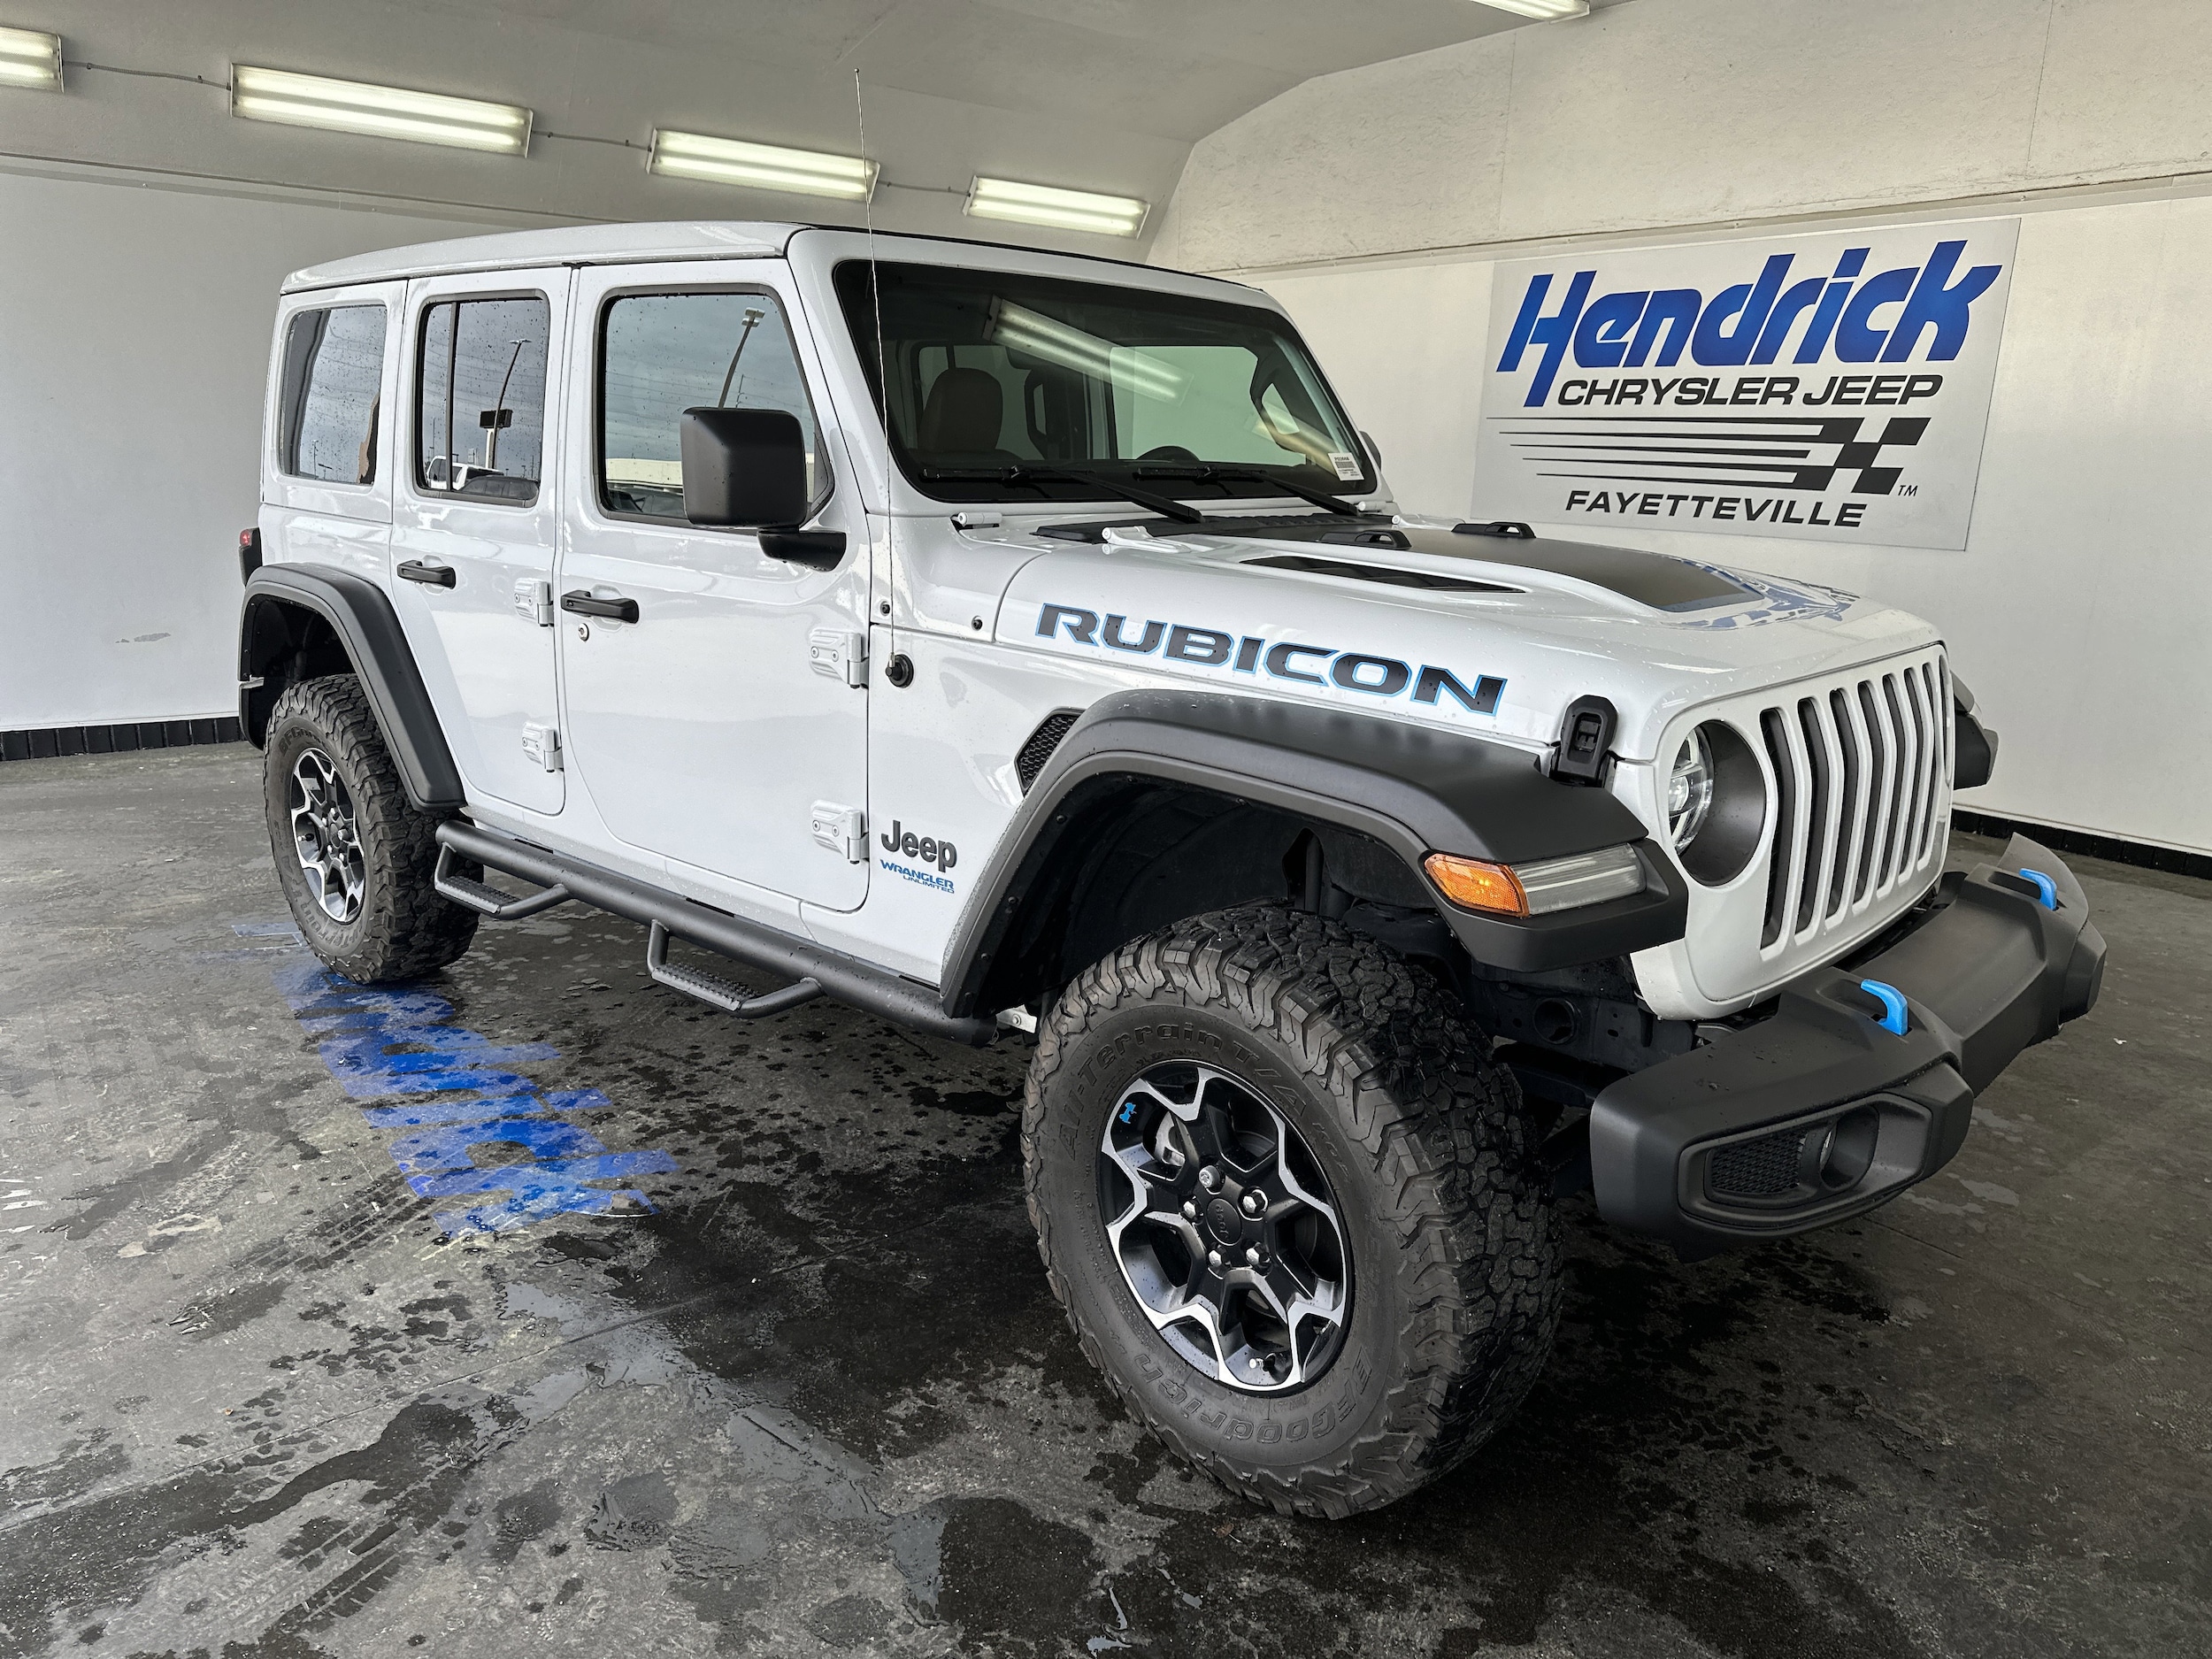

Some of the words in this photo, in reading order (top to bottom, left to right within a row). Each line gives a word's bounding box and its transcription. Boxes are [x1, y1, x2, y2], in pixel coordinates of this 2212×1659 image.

[1496, 240, 2002, 407] Hendrick
[1557, 375, 1800, 405] CHRYSLER
[1802, 375, 1943, 405] JEEP
[1565, 490, 1867, 527] FAYETTEVILLE
[1898, 485, 1918, 496] TM
[1035, 603, 1508, 717] RUBICON
[881, 819, 957, 873] Jeep
[880, 858, 955, 890] WRANGLER
[903, 875, 955, 894] UNLIMITED
[1134, 1345, 1372, 1444] BFGoodrich
